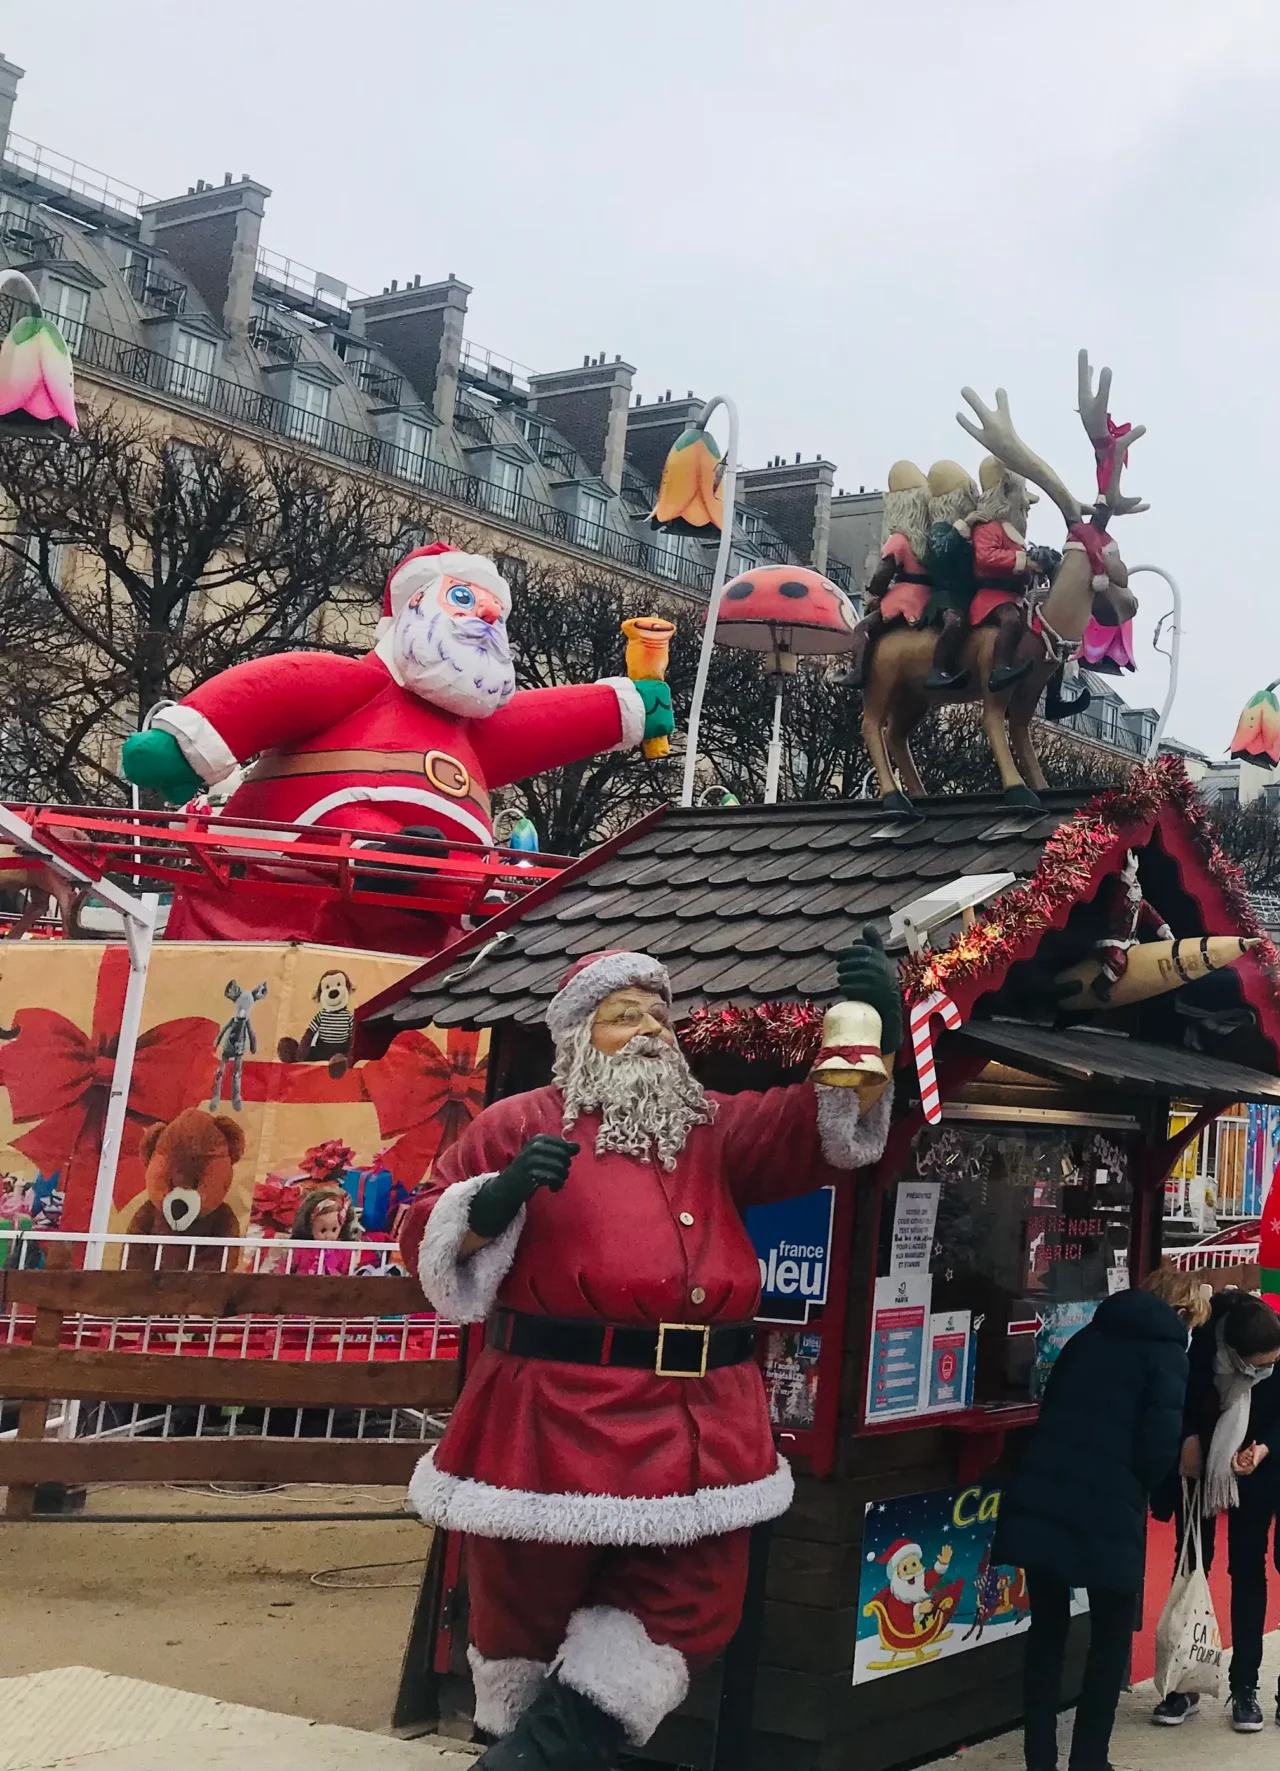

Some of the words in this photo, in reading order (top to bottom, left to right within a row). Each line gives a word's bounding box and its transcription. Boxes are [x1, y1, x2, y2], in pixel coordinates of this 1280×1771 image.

[1068, 1218, 1104, 1237] NOEL
[779, 1240, 824, 1259] france
[894, 1296, 909, 1304] PARIS
[1193, 1622, 1207, 1645] ÇA
[1188, 1644, 1215, 1665] POUR
